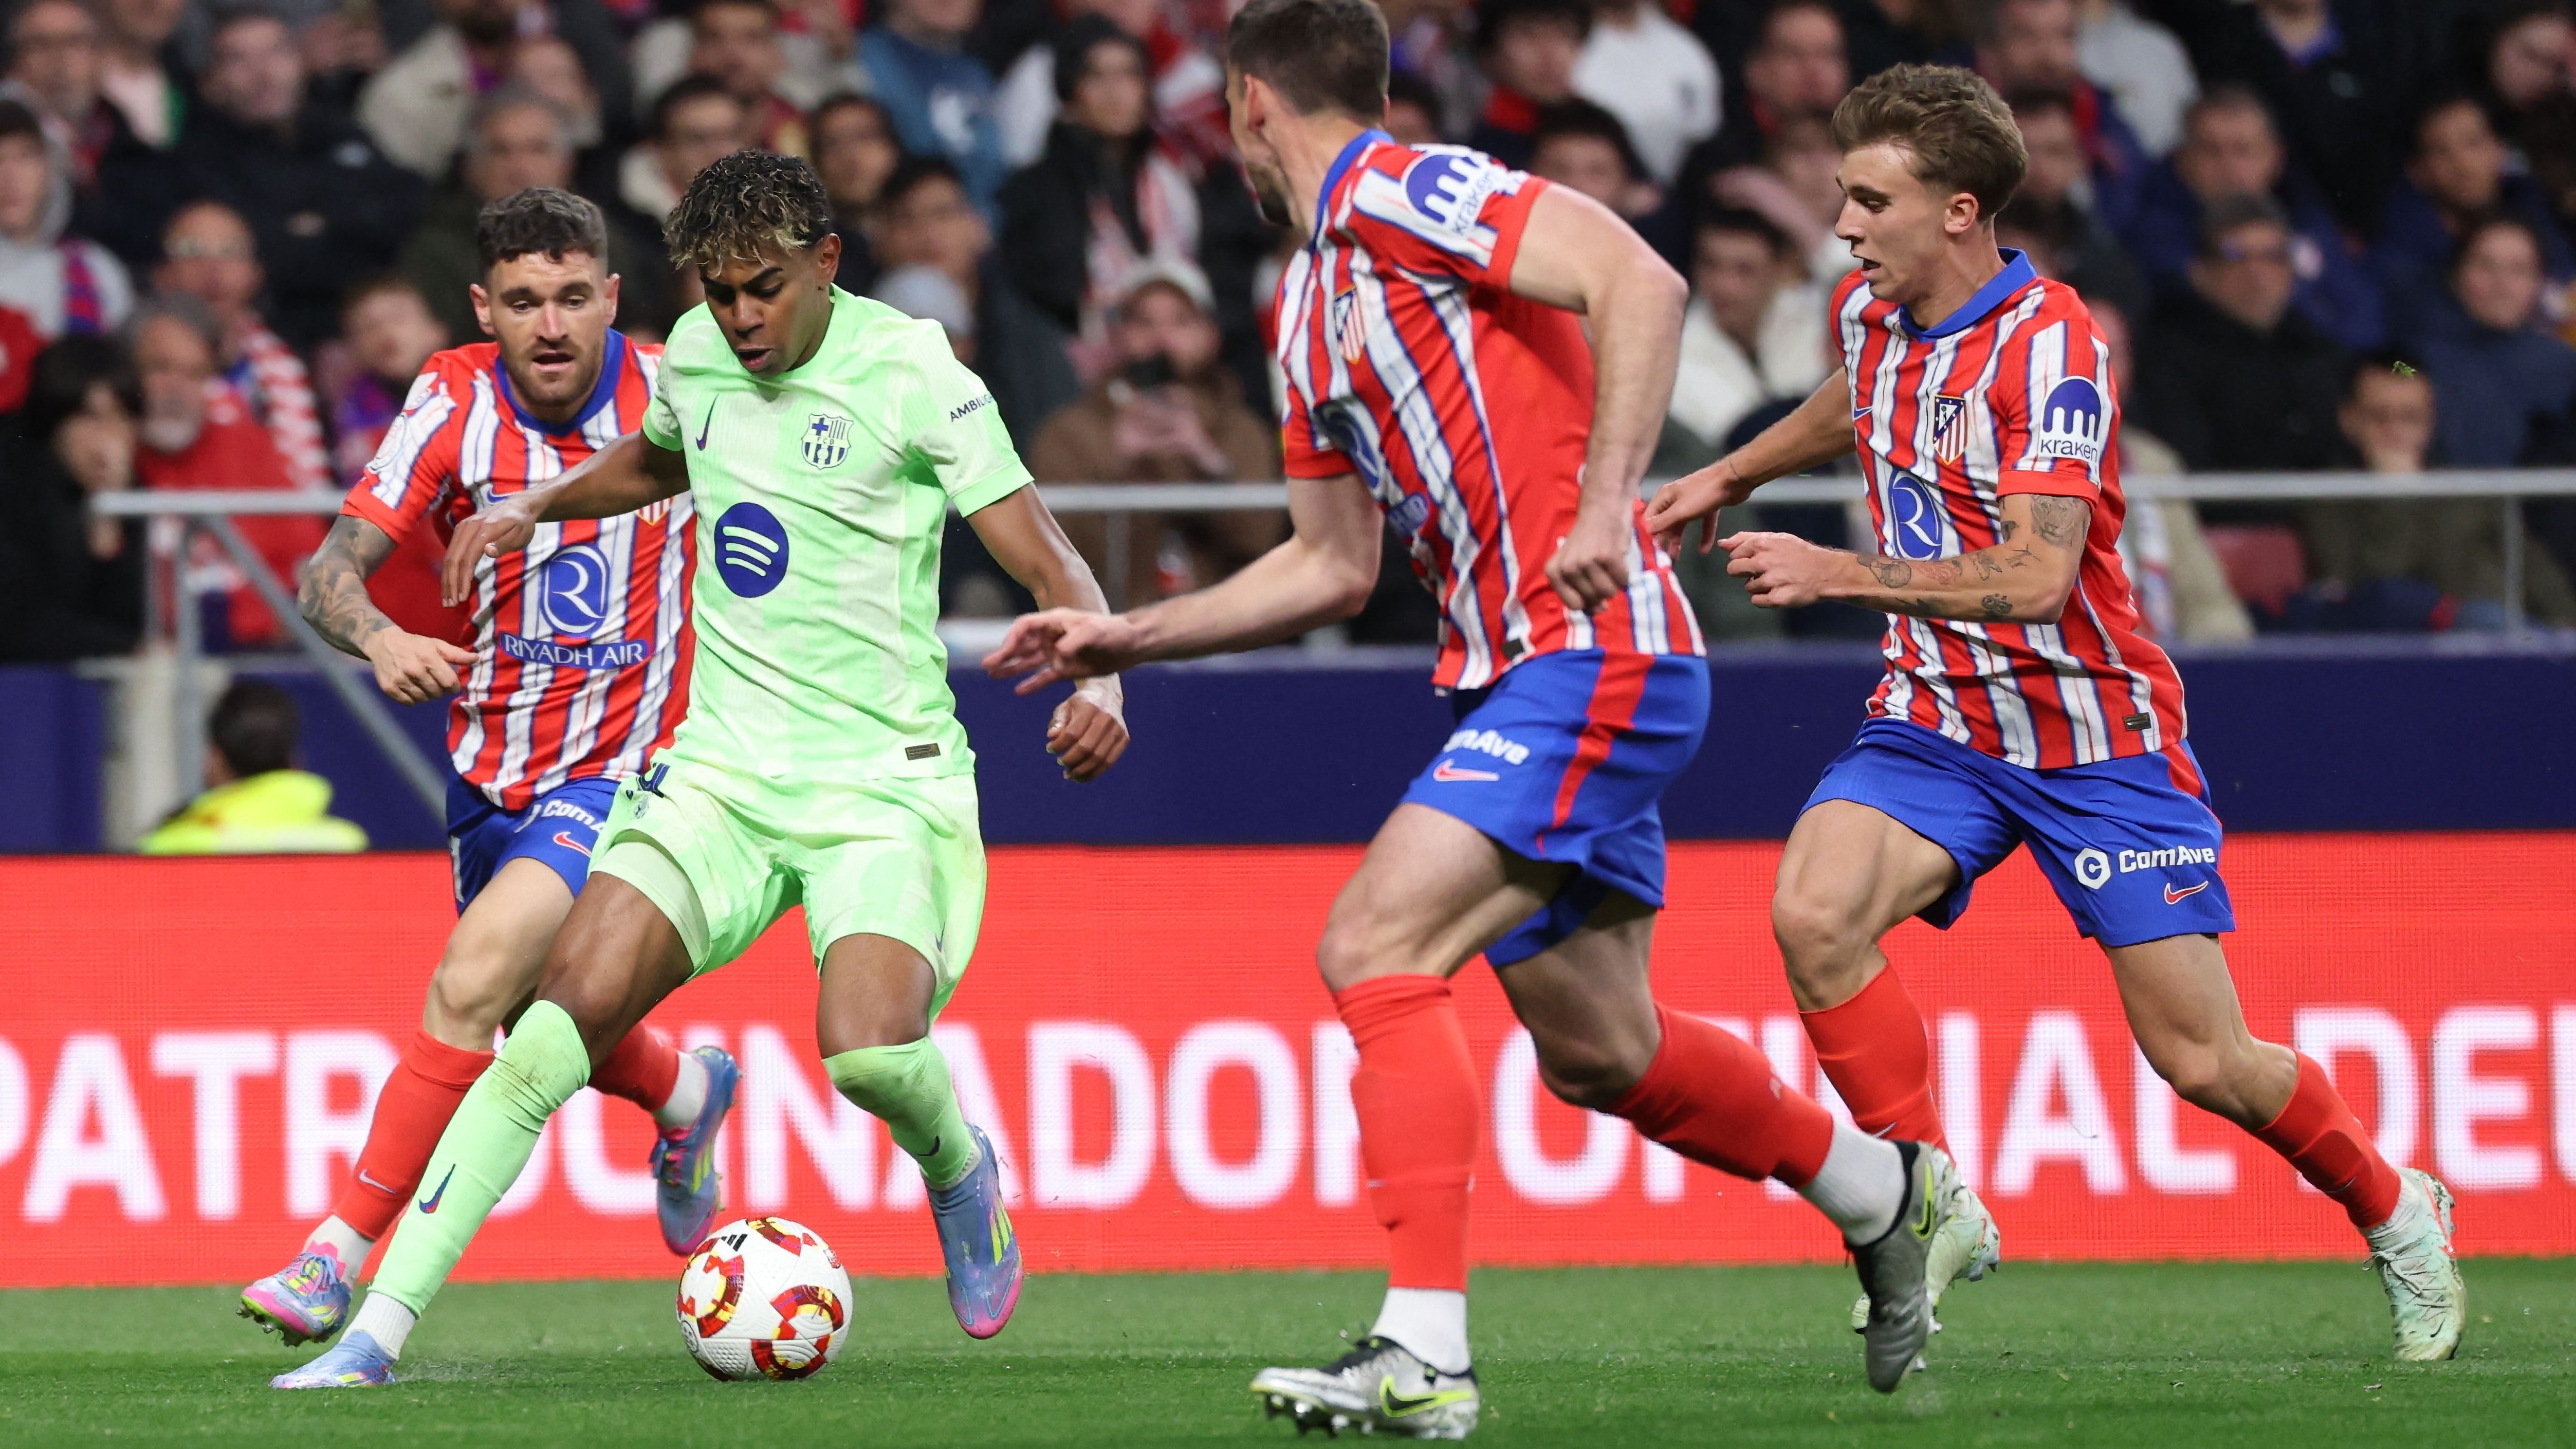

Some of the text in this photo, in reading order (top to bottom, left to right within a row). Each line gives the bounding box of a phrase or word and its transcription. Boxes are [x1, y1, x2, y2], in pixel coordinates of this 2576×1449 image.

[2040, 439, 2097, 463] kraken
[503, 634, 643, 667] RIYADH AIR
[541, 800, 607, 834] ComA
[2119, 845, 2215, 873] ComAve
